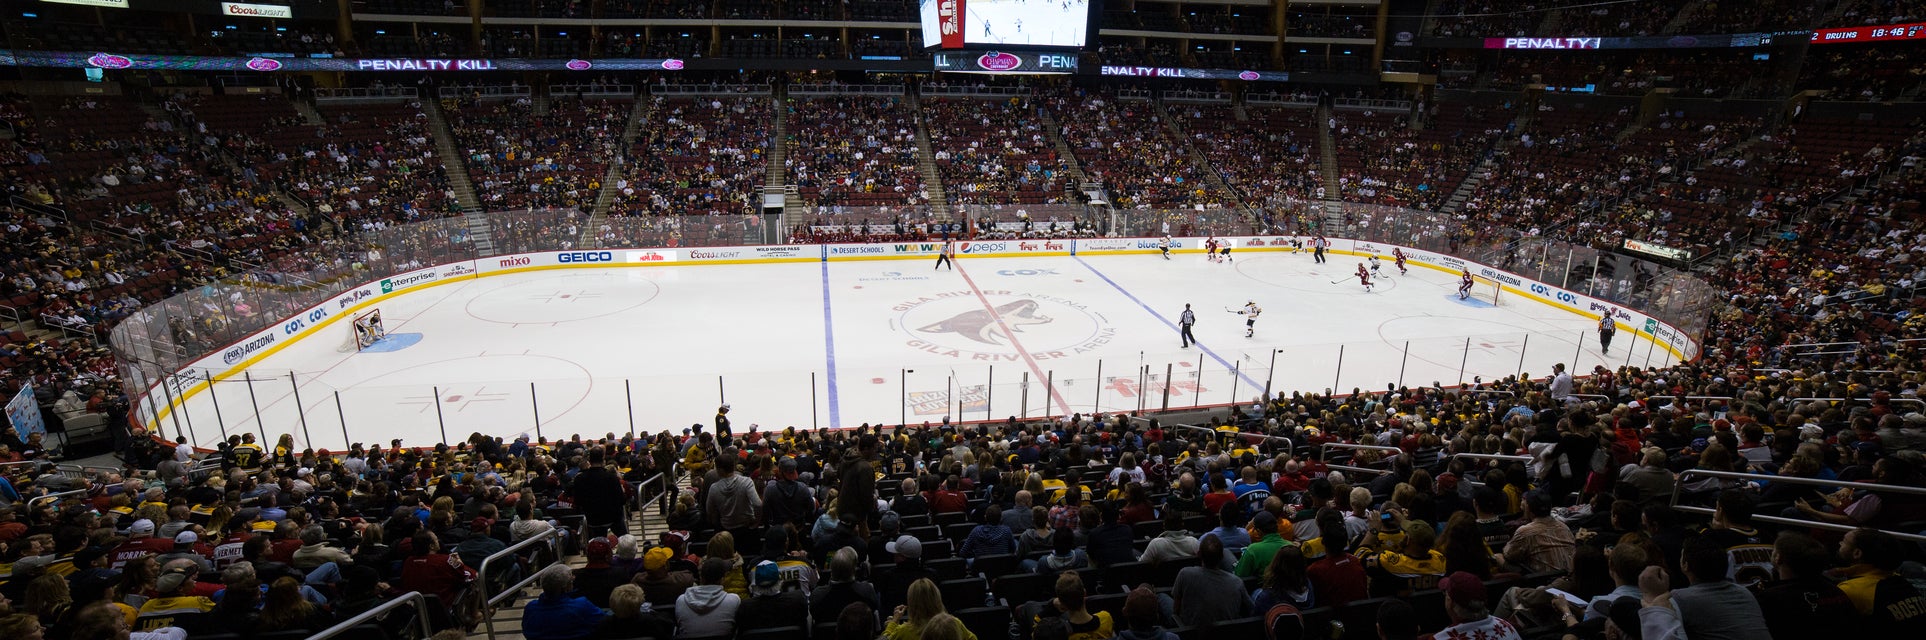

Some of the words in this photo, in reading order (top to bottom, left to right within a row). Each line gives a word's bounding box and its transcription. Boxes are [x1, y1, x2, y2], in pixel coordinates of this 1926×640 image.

[1825, 31, 1858, 40] BRUINS
[1871, 27, 1905, 38] 18:46
[1505, 38, 1592, 49] PENALTY
[359, 59, 451, 70] PENALTY
[457, 60, 498, 70] KILL
[1157, 68, 1186, 78] KILL
[860, 246, 885, 254] SCHOOLS
[894, 244, 919, 252] WM
[972, 242, 1007, 254] pepsi
[1137, 240, 1182, 249] bluedia
[558, 251, 612, 263] GEICO
[690, 249, 716, 259] Coors
[715, 251, 741, 259] LIGHT
[1414, 254, 1437, 264] LIGHT
[996, 269, 1060, 277] COX
[383, 271, 435, 290] enterprise
[1496, 273, 1521, 287] ARIZONA
[1531, 283, 1550, 297] COX
[1557, 291, 1577, 305] COX
[892, 296, 933, 312] GILA
[935, 289, 1012, 299] RIVER
[1013, 292, 1088, 311] ARENA
[309, 307, 328, 323] COX
[285, 317, 305, 335] COX
[245, 333, 275, 355] ARIZONA
[906, 338, 961, 359] GILA
[971, 350, 1068, 362] RIVER
[1073, 326, 1118, 355] ARENA
[227, 350, 241, 360] FOX
[235, 453, 251, 467] 37
[116, 550, 148, 561] MORRIS
